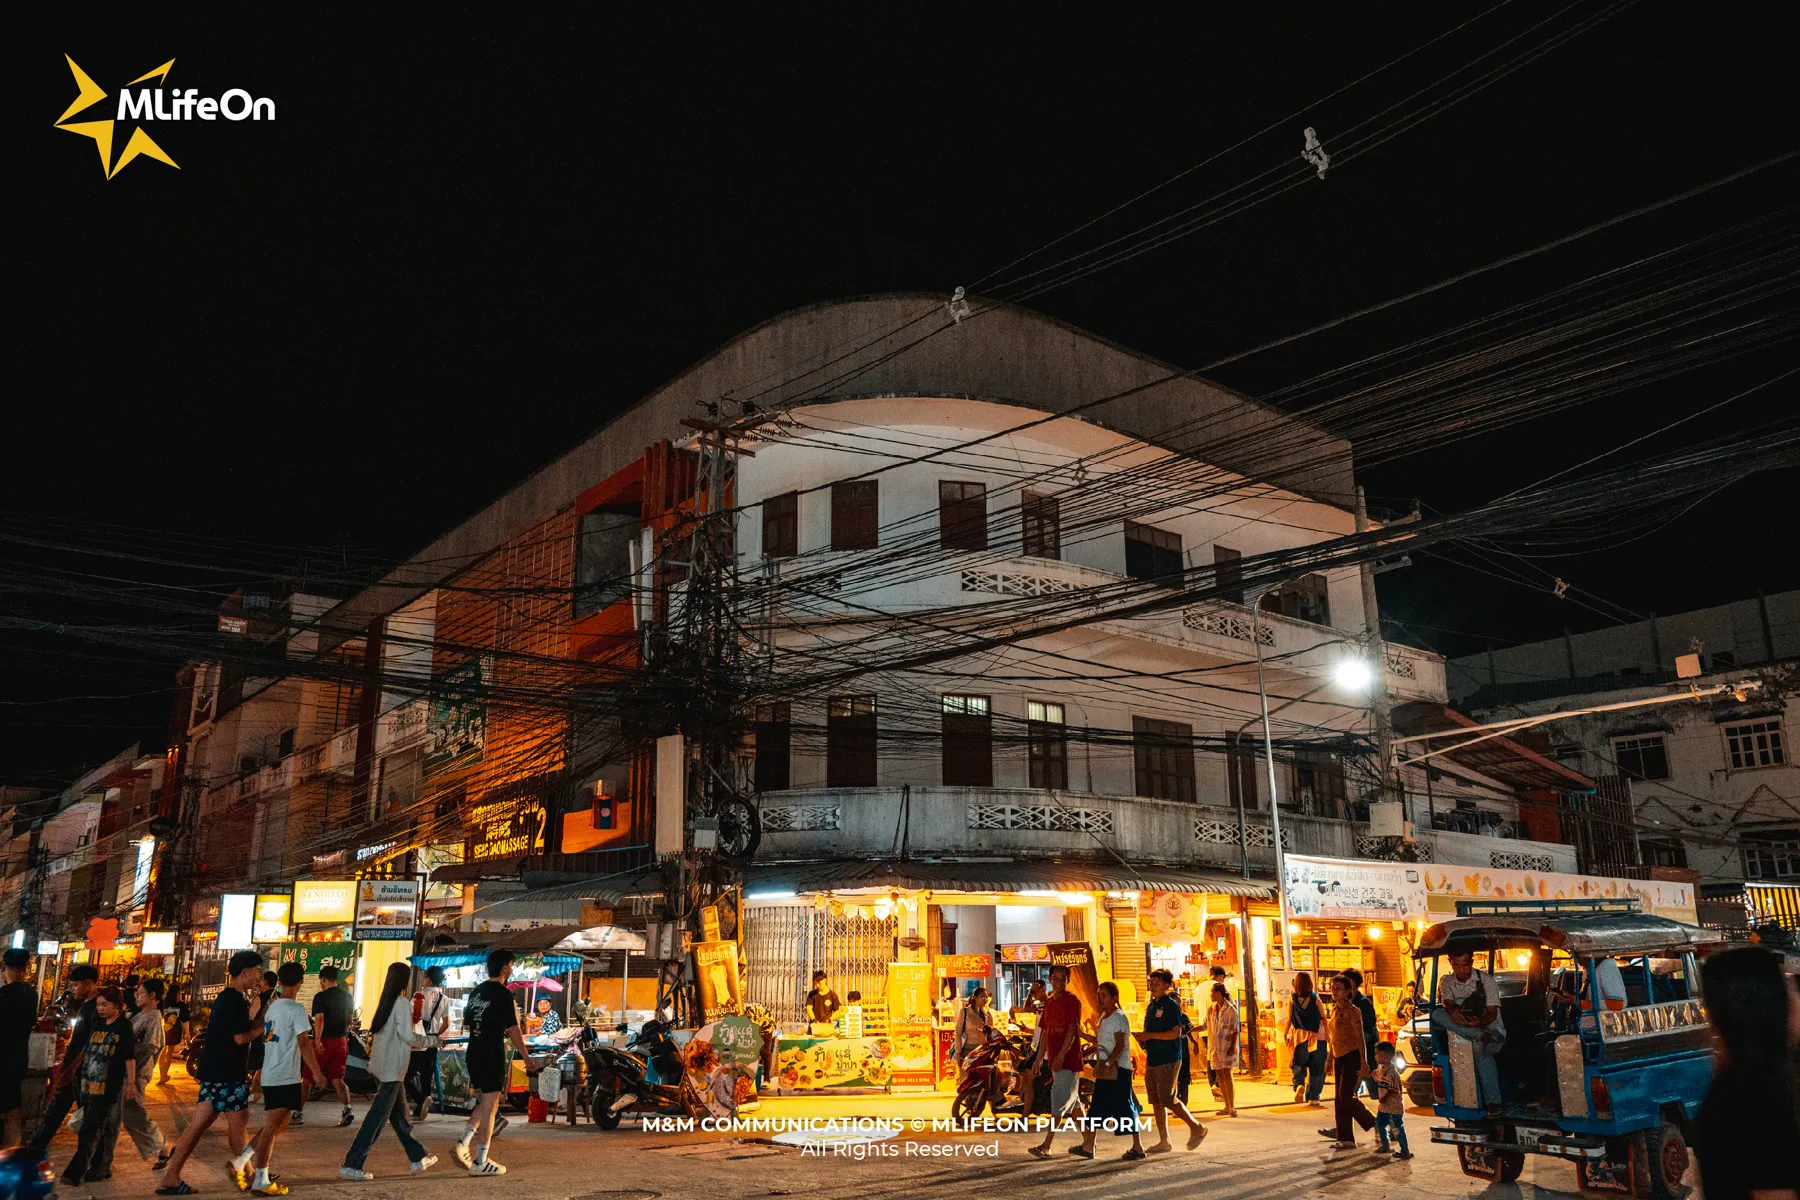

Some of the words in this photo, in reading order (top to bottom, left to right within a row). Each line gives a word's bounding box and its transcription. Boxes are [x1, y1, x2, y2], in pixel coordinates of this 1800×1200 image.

[534, 807, 547, 848] 2
[283, 948, 297, 963] M
[300, 948, 308, 960] 5
